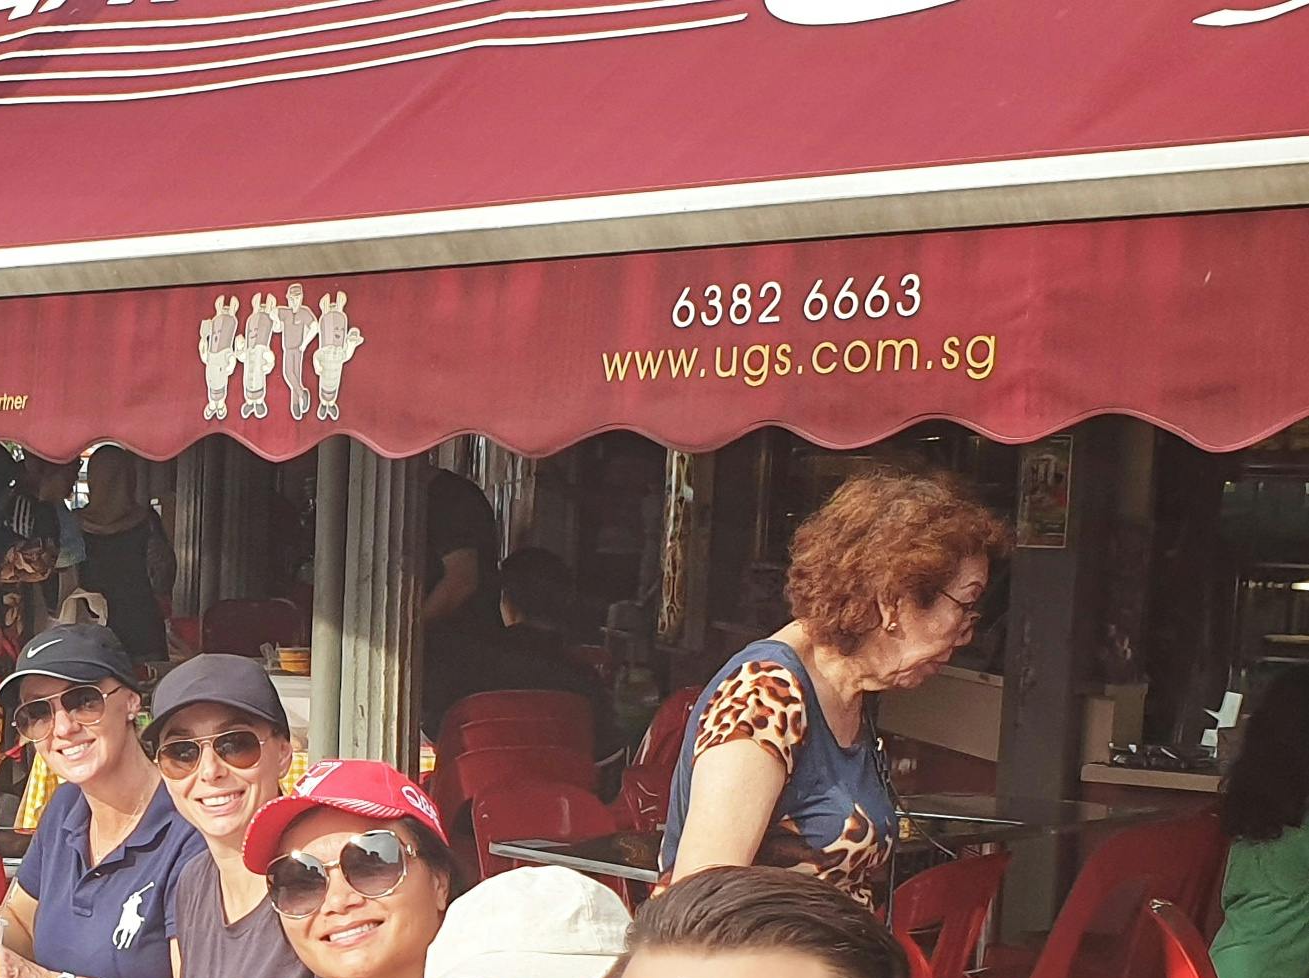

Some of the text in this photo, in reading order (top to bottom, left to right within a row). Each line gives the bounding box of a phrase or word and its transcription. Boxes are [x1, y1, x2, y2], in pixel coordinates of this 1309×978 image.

[671, 273, 922, 328] 6382 6663
[602, 334, 996, 387] www.ugs.com.sg
